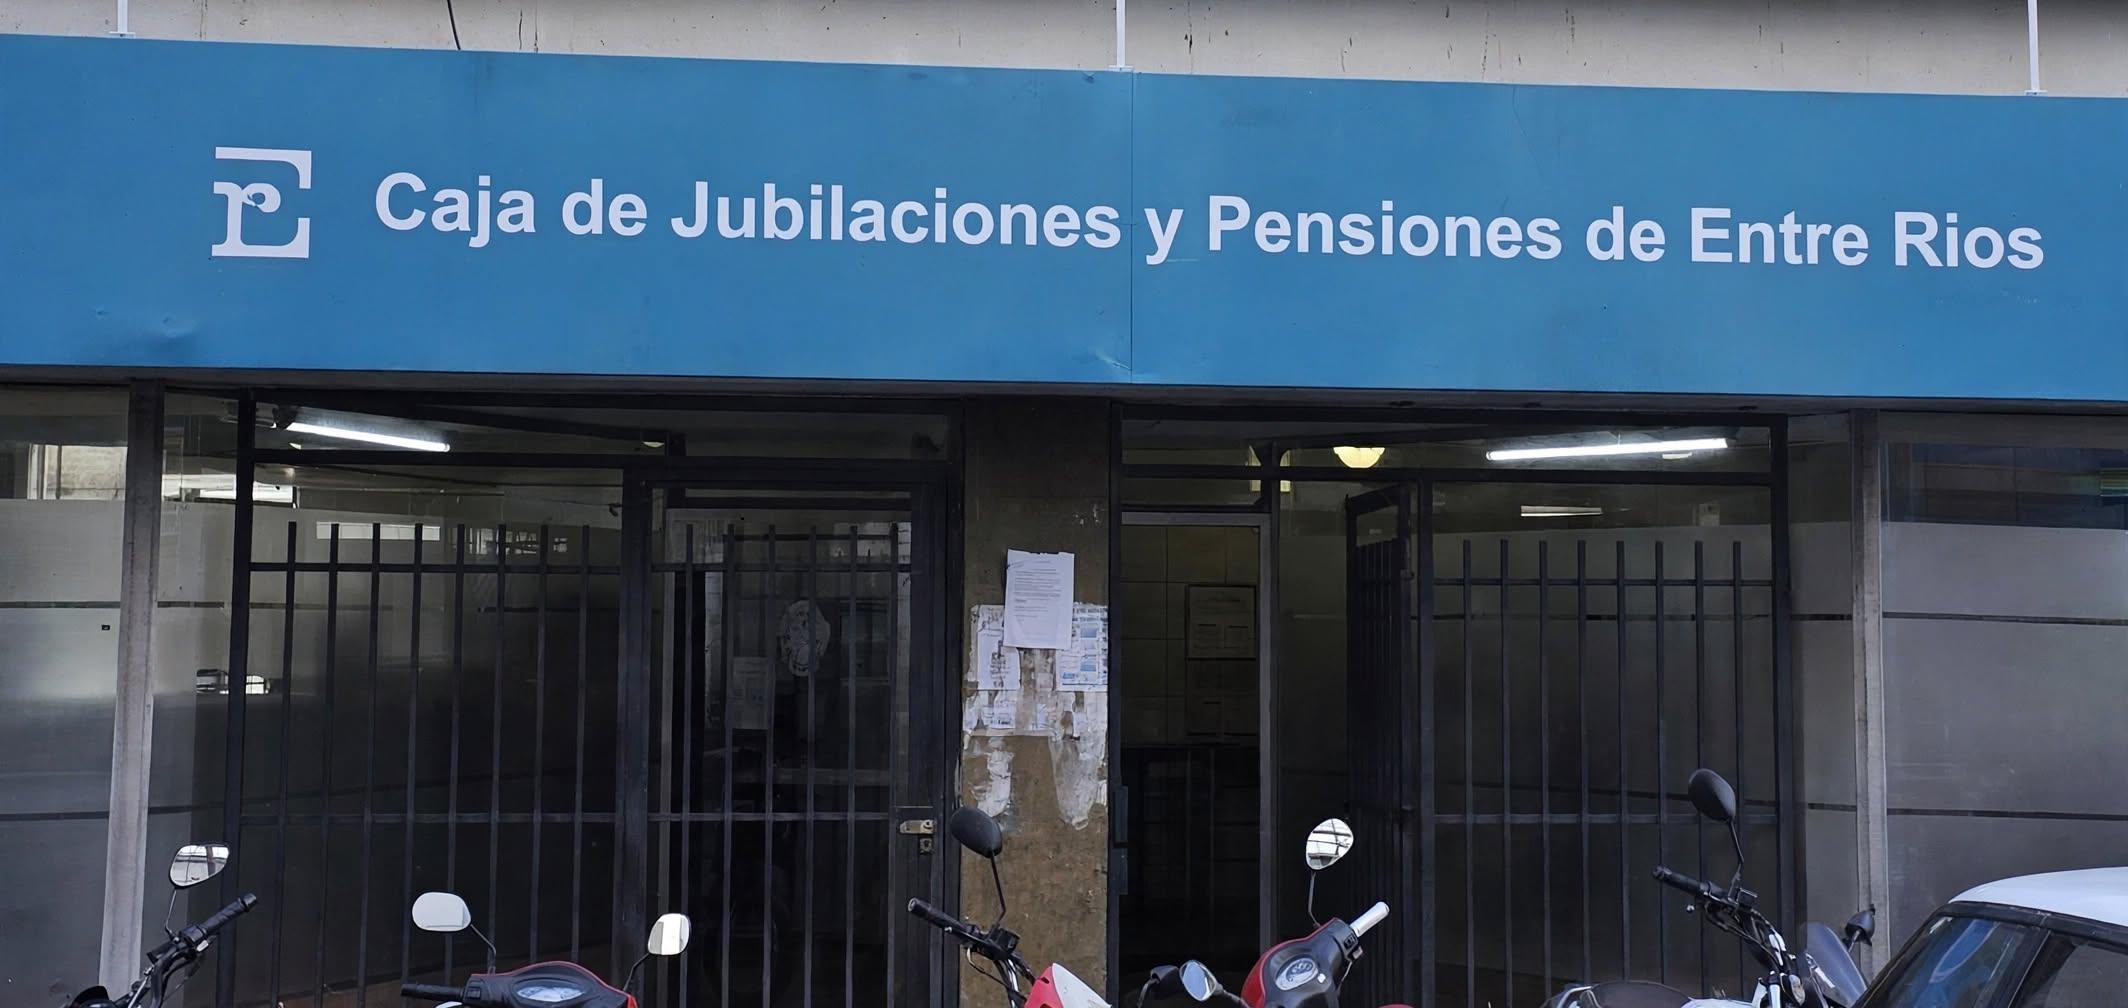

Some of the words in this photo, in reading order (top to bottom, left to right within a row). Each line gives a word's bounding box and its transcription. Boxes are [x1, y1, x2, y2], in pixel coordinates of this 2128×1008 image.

[375, 172, 536, 248] Caja
[562, 178, 647, 236] de
[671, 181, 1121, 249] Jubilaciones
[1144, 208, 1184, 265] y
[1209, 195, 1562, 260] Pensiones
[1586, 205, 1666, 262] de
[1691, 207, 1869, 266] Entre
[1894, 211, 2044, 269] Rios
